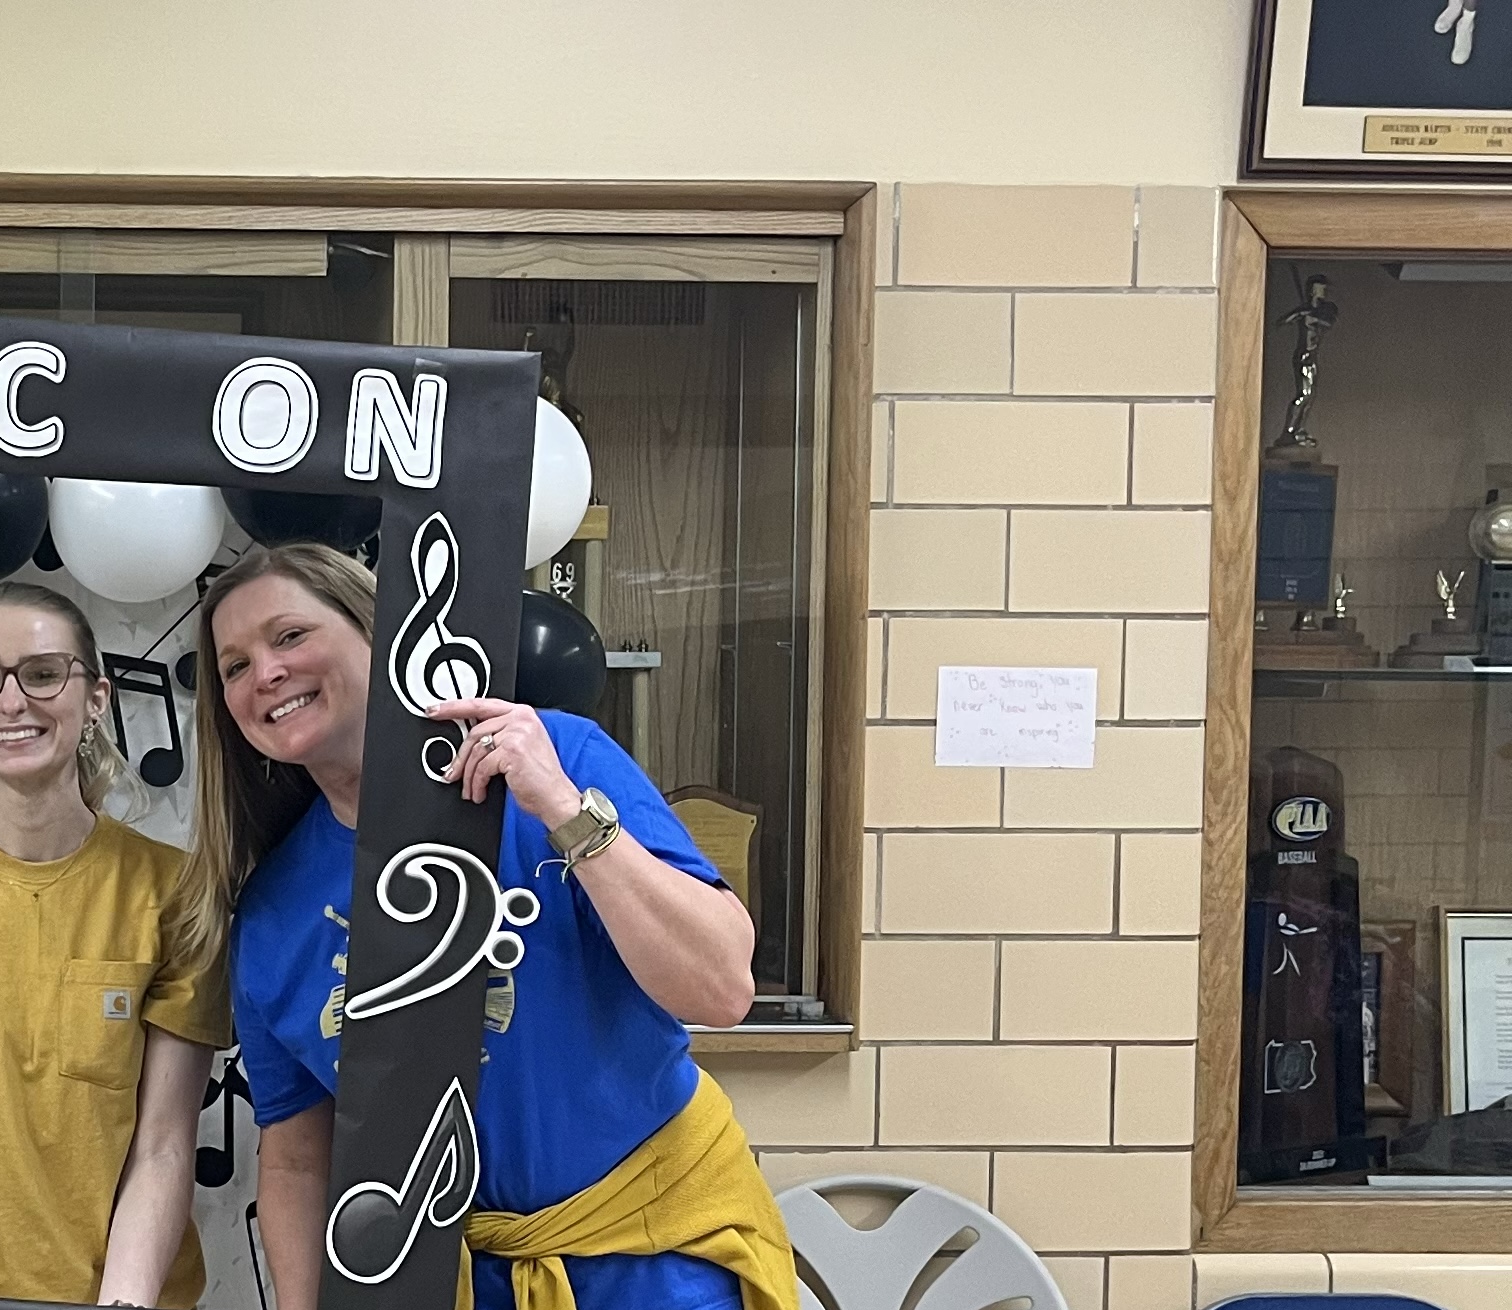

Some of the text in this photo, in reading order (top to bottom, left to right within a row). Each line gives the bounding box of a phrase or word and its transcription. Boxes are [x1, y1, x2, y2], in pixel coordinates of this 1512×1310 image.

[213, 356, 448, 489] ON
[552, 562, 575, 583] 69
[968, 672, 987, 691] Be
[1277, 850, 1317, 865] BASEBALL
